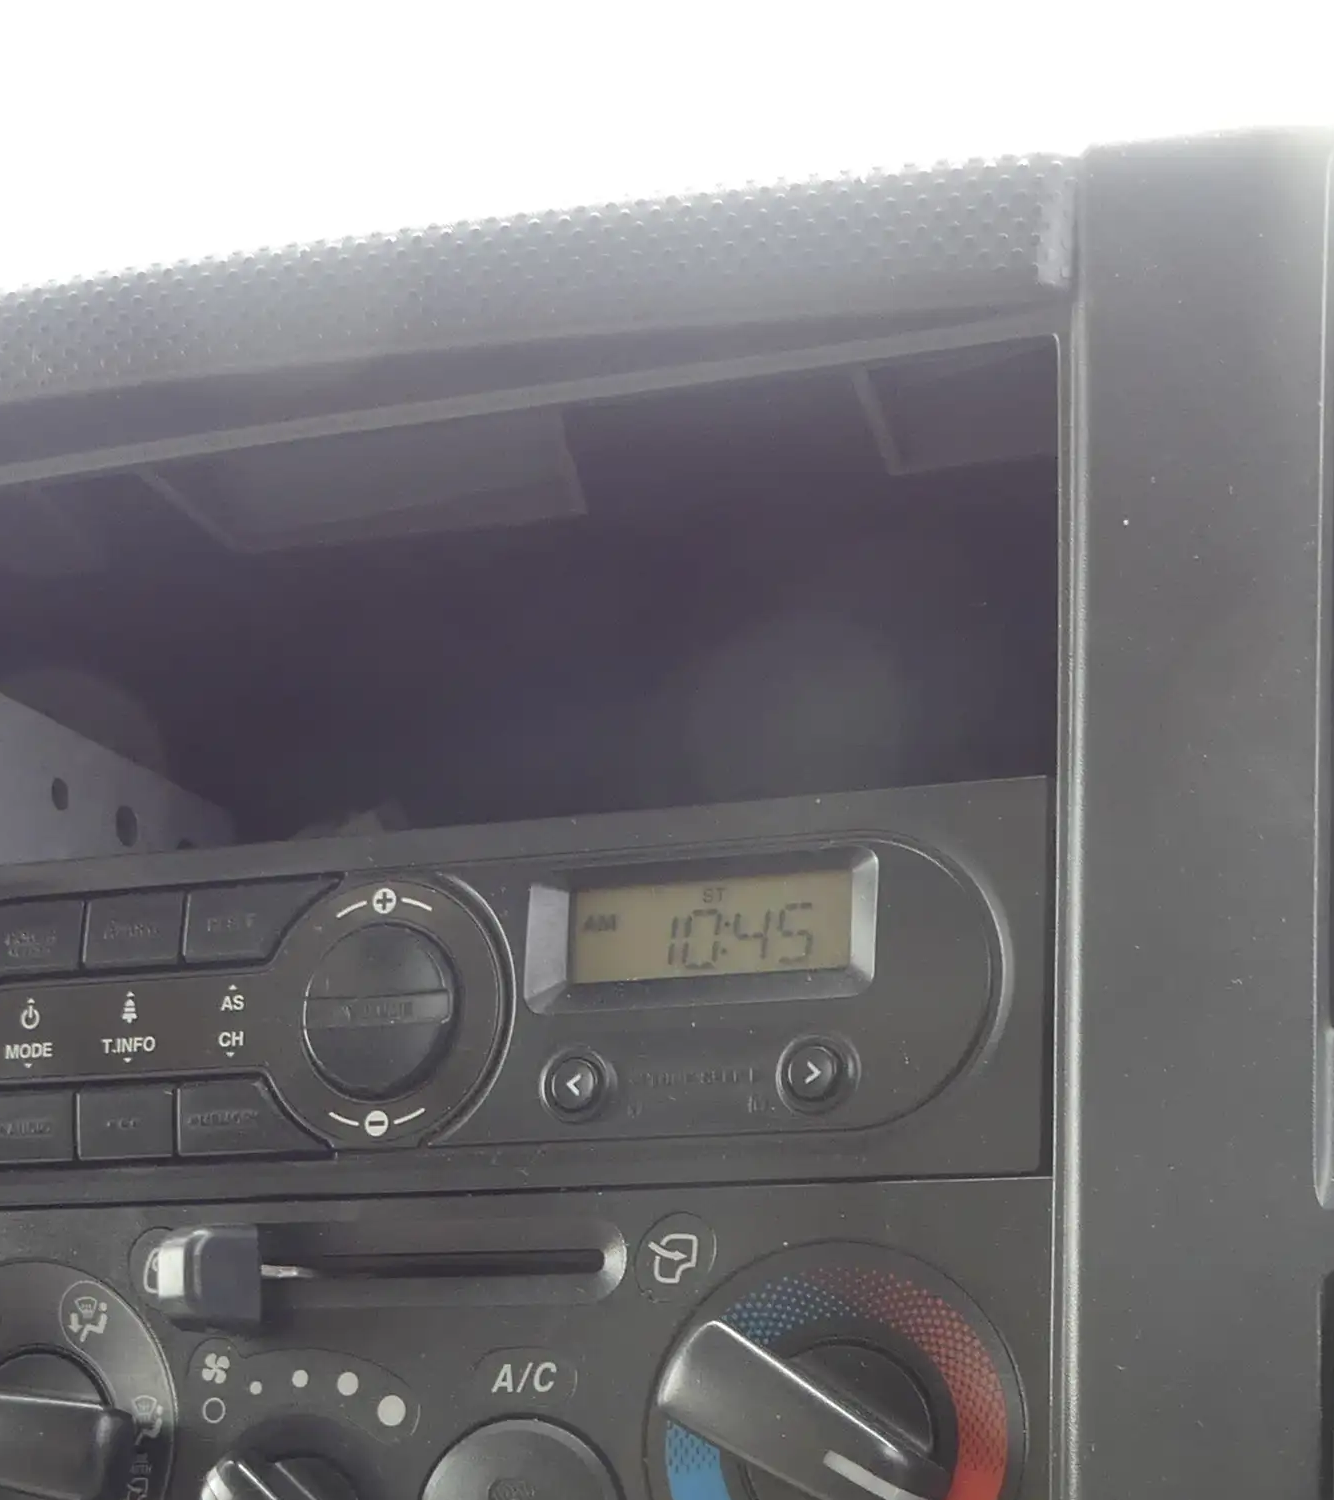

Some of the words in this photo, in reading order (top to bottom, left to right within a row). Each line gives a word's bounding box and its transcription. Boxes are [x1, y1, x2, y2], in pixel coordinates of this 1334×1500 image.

[666, 901, 814, 970] 10:45
[220, 994, 245, 1012] AS
[101, 1035, 156, 1055] T.INFO
[218, 1030, 244, 1048] CH
[4, 1041, 54, 1060] MODE
[491, 1360, 558, 1395] A/C
